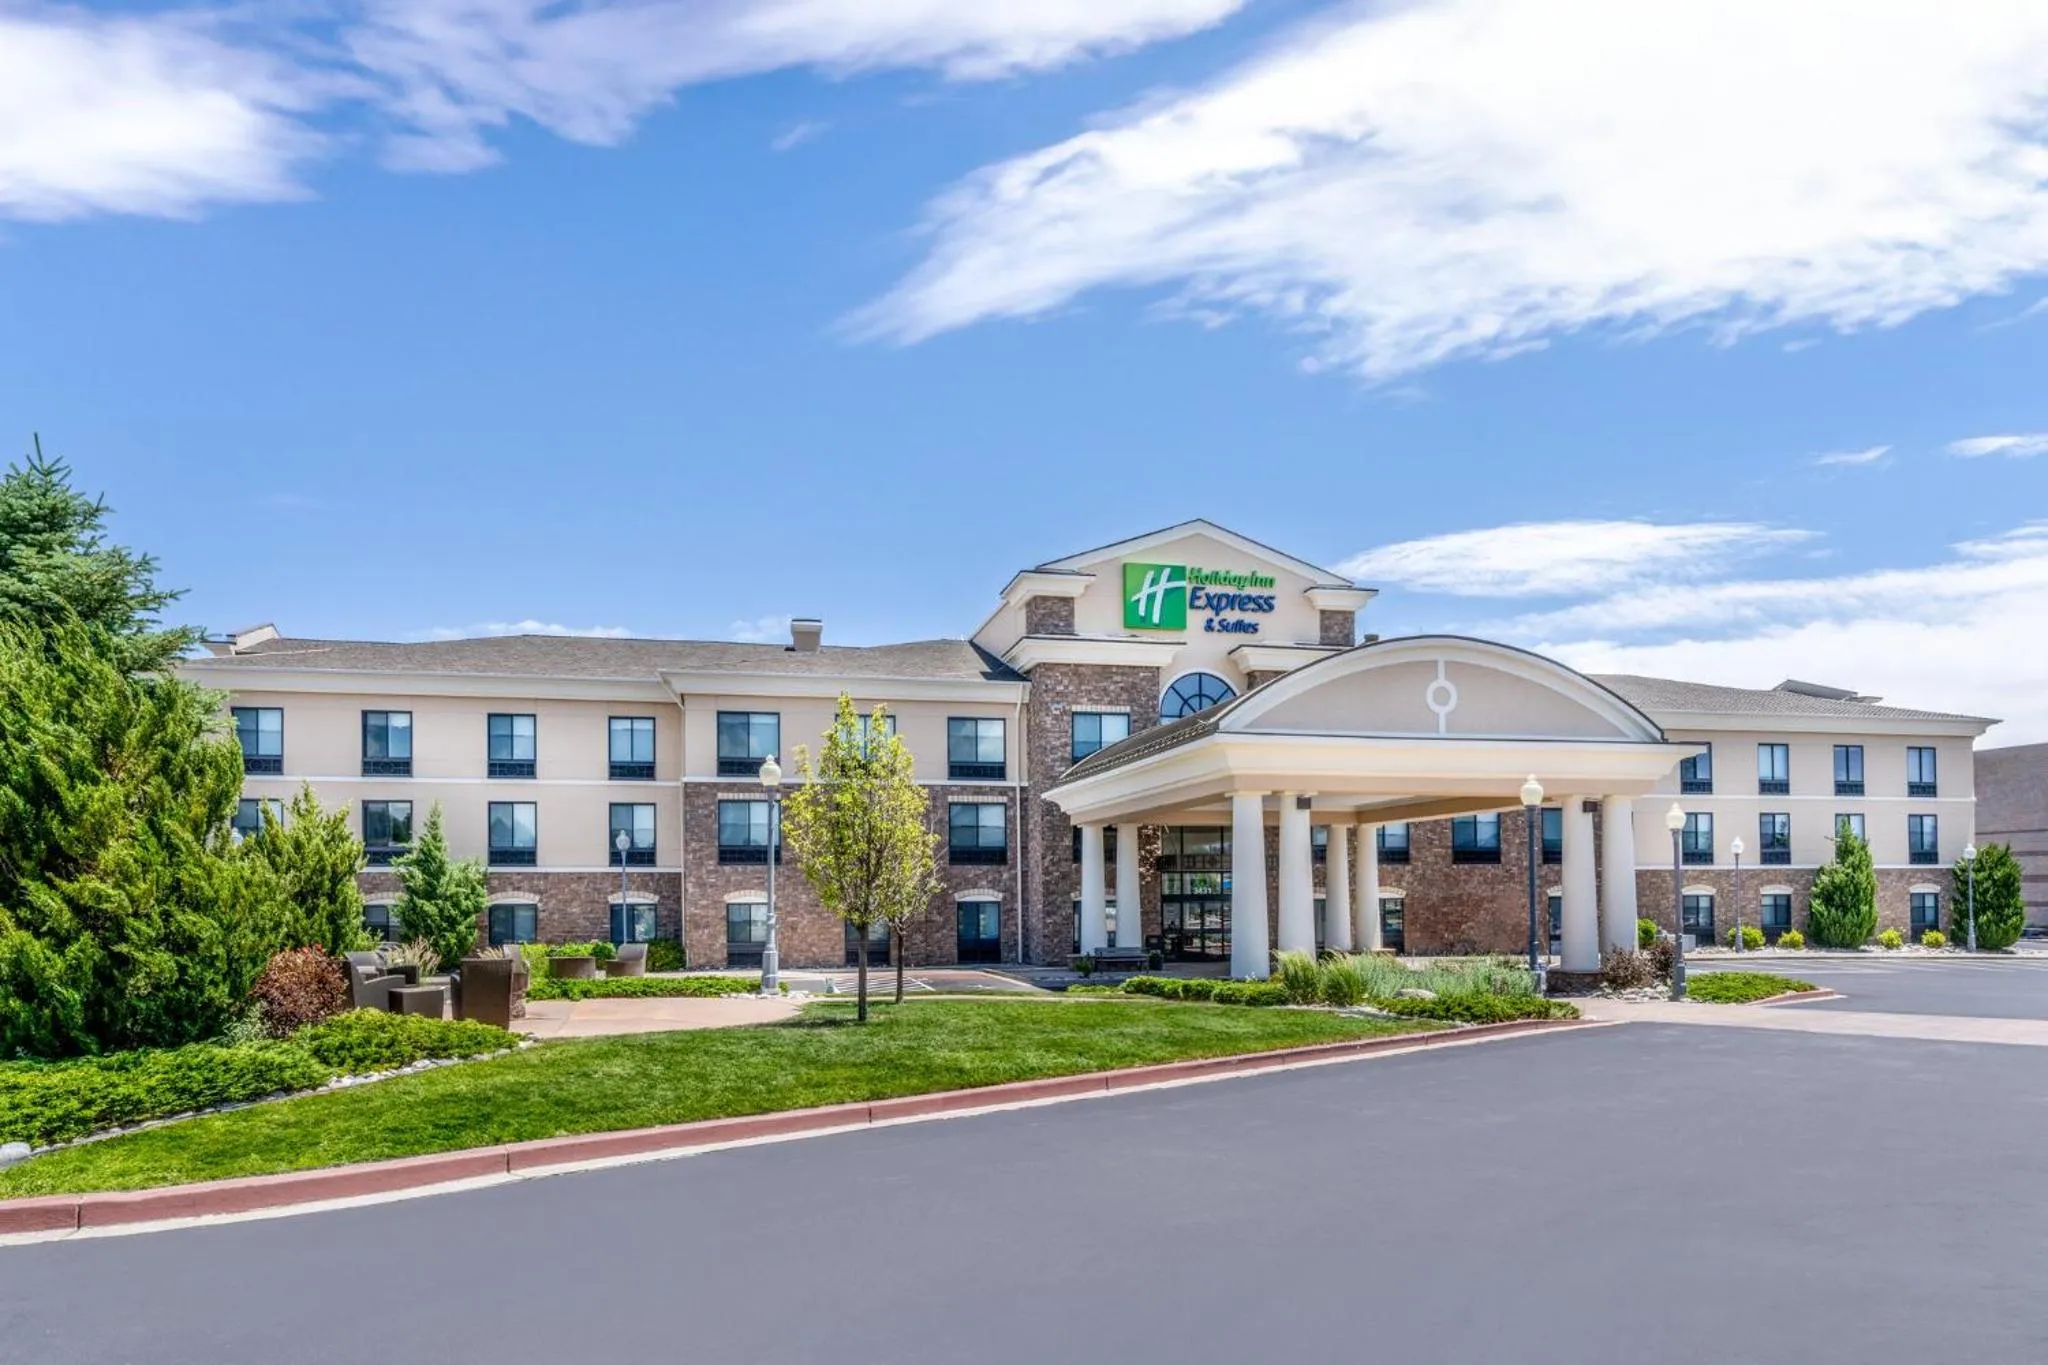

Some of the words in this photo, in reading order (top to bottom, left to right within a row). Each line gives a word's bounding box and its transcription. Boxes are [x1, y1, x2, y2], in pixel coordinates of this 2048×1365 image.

[1188, 567, 1247, 590] Holiday
[1250, 570, 1275, 588] Inn
[1189, 586, 1276, 616] Express
[1204, 618, 1215, 632] &
[1216, 618, 1260, 634] Suites
